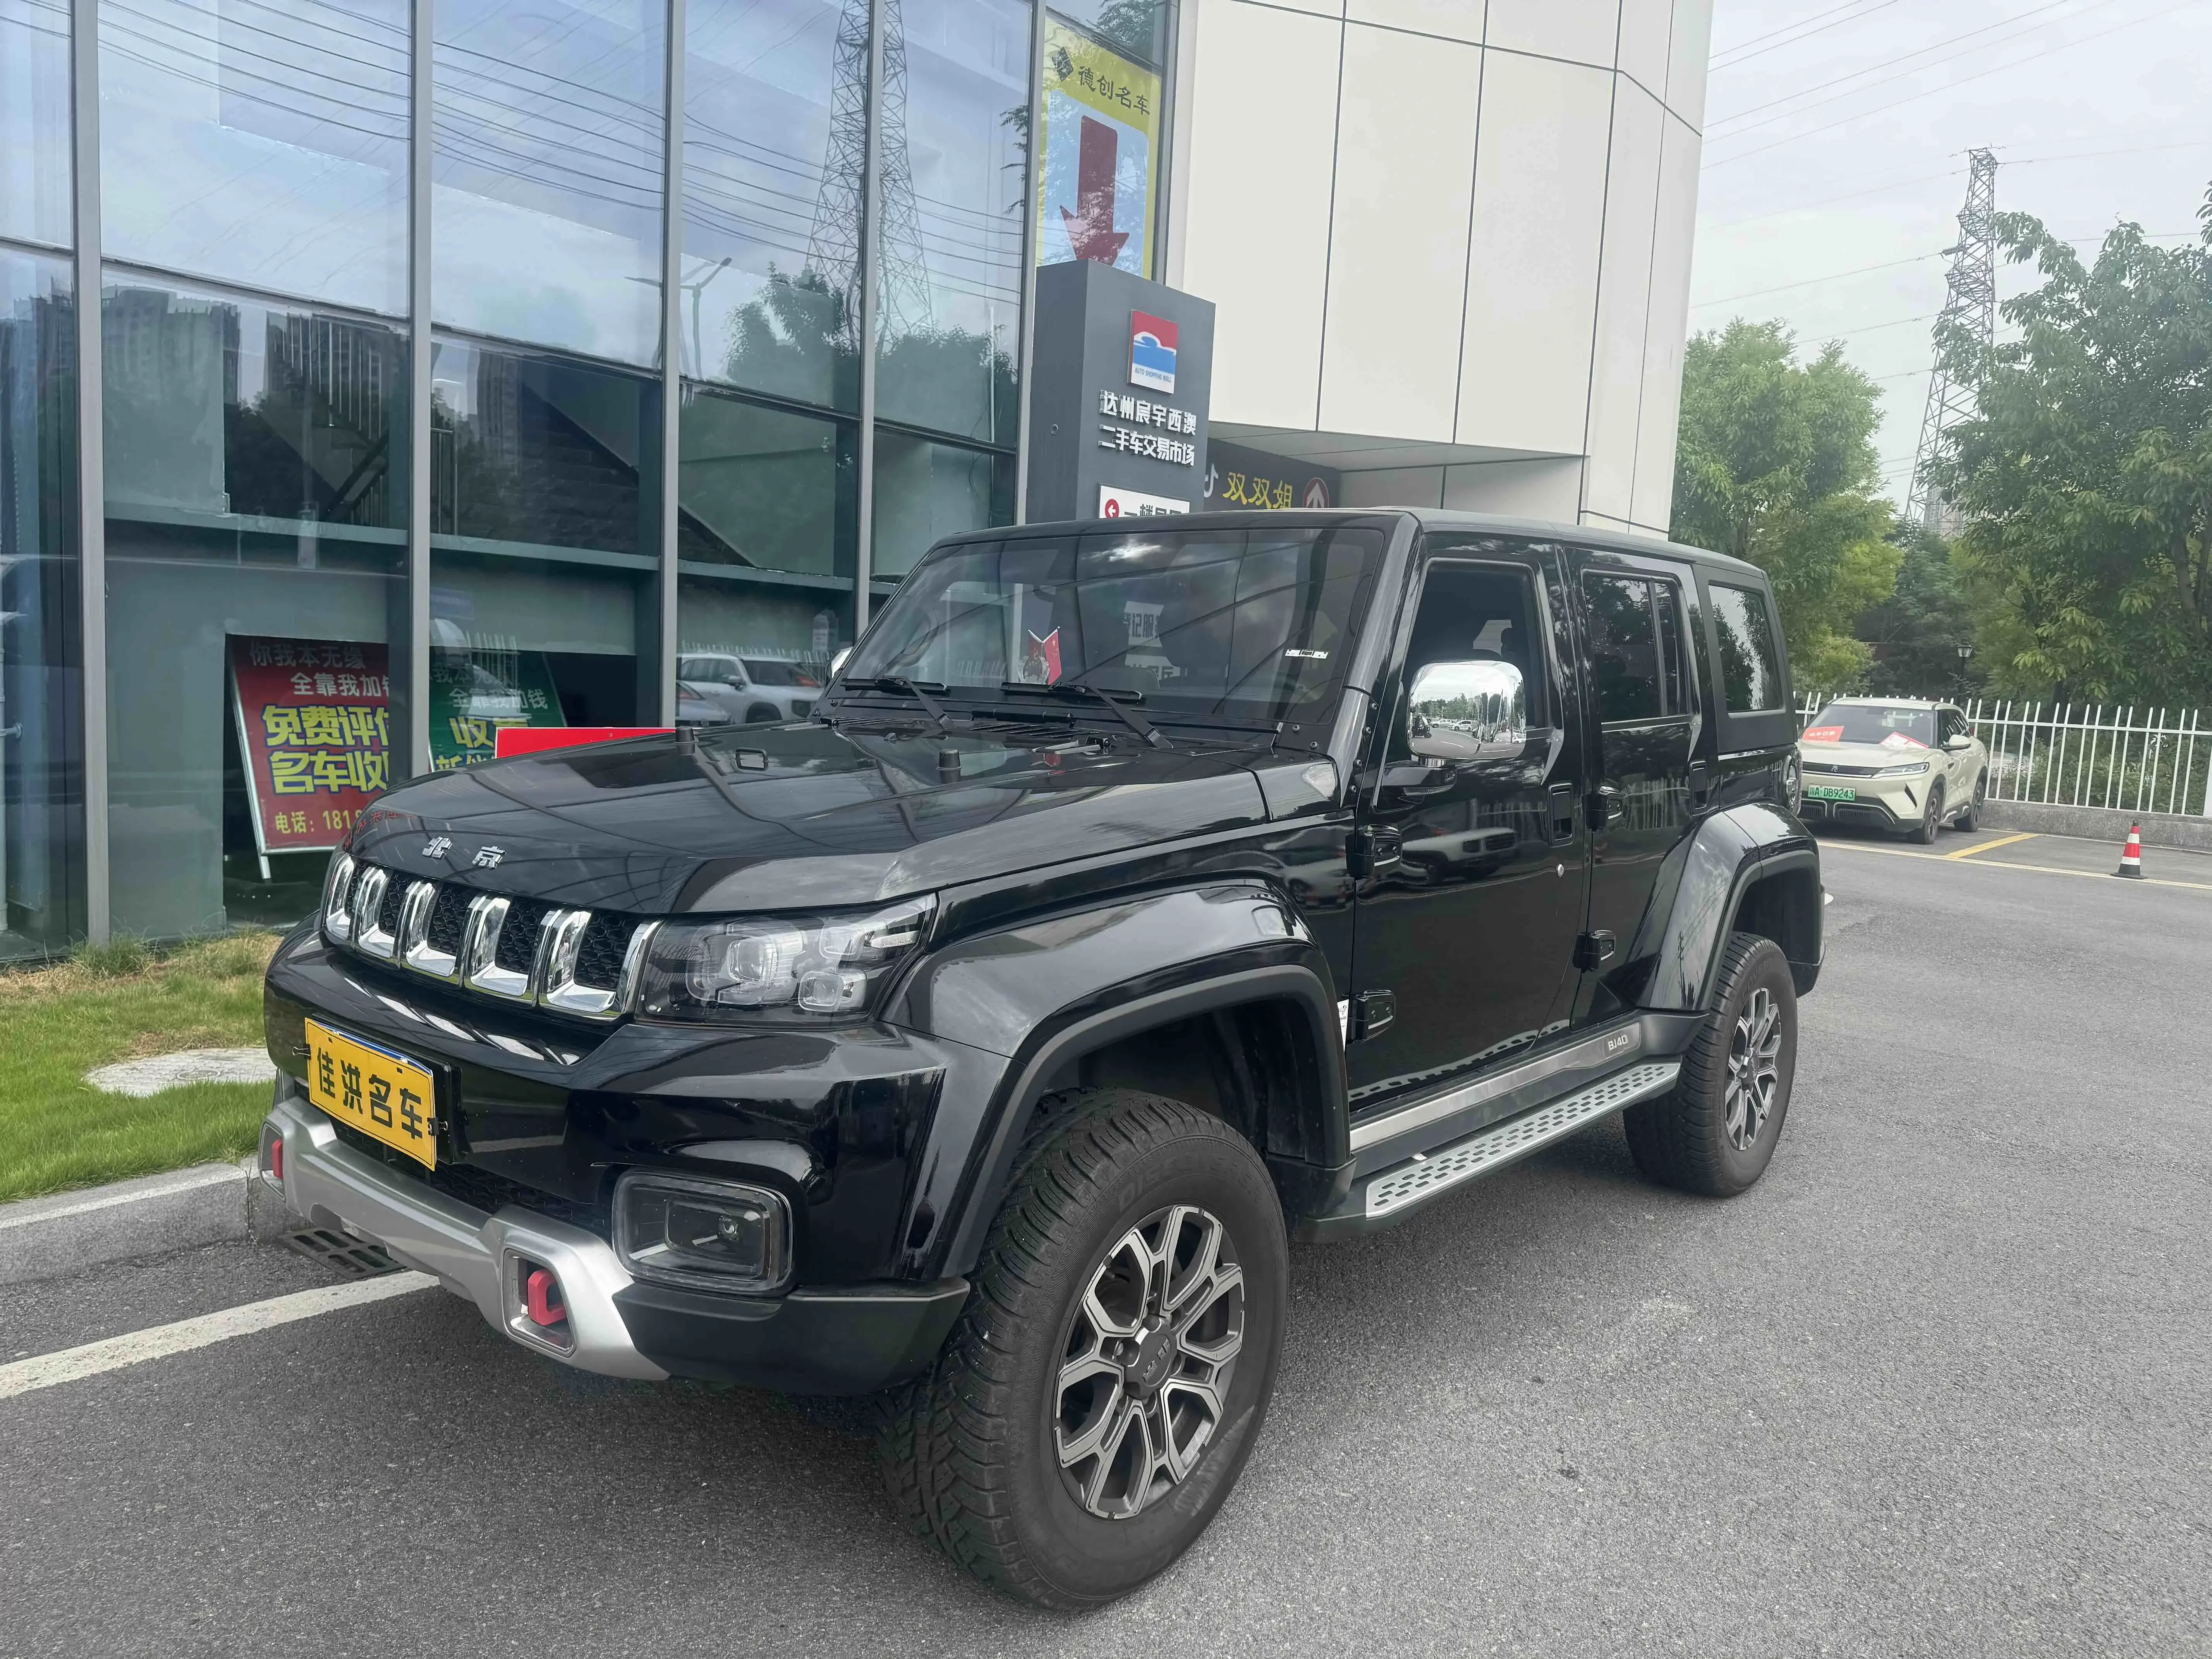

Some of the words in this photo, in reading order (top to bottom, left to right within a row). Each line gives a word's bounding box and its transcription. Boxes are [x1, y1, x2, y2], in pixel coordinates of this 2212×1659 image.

[1078, 66, 1150, 115] 德创名车
[1146, 370, 1162, 380] SHOPPING
[1163, 374, 1171, 382] MALL
[1099, 390, 1196, 435] 达州宸宇西澳
[1097, 424, 1195, 466] 二手车交易市场
[1222, 471, 1292, 508] 双双姐
[250, 641, 366, 669] 你我本无缘
[449, 687, 548, 709] 全靠我加钱
[270, 749, 388, 794] 名车收
[422, 836, 507, 869] 北京
[1608, 1034, 1628, 1051] BJ40
[317, 1046, 423, 1140] 佳洪名车
